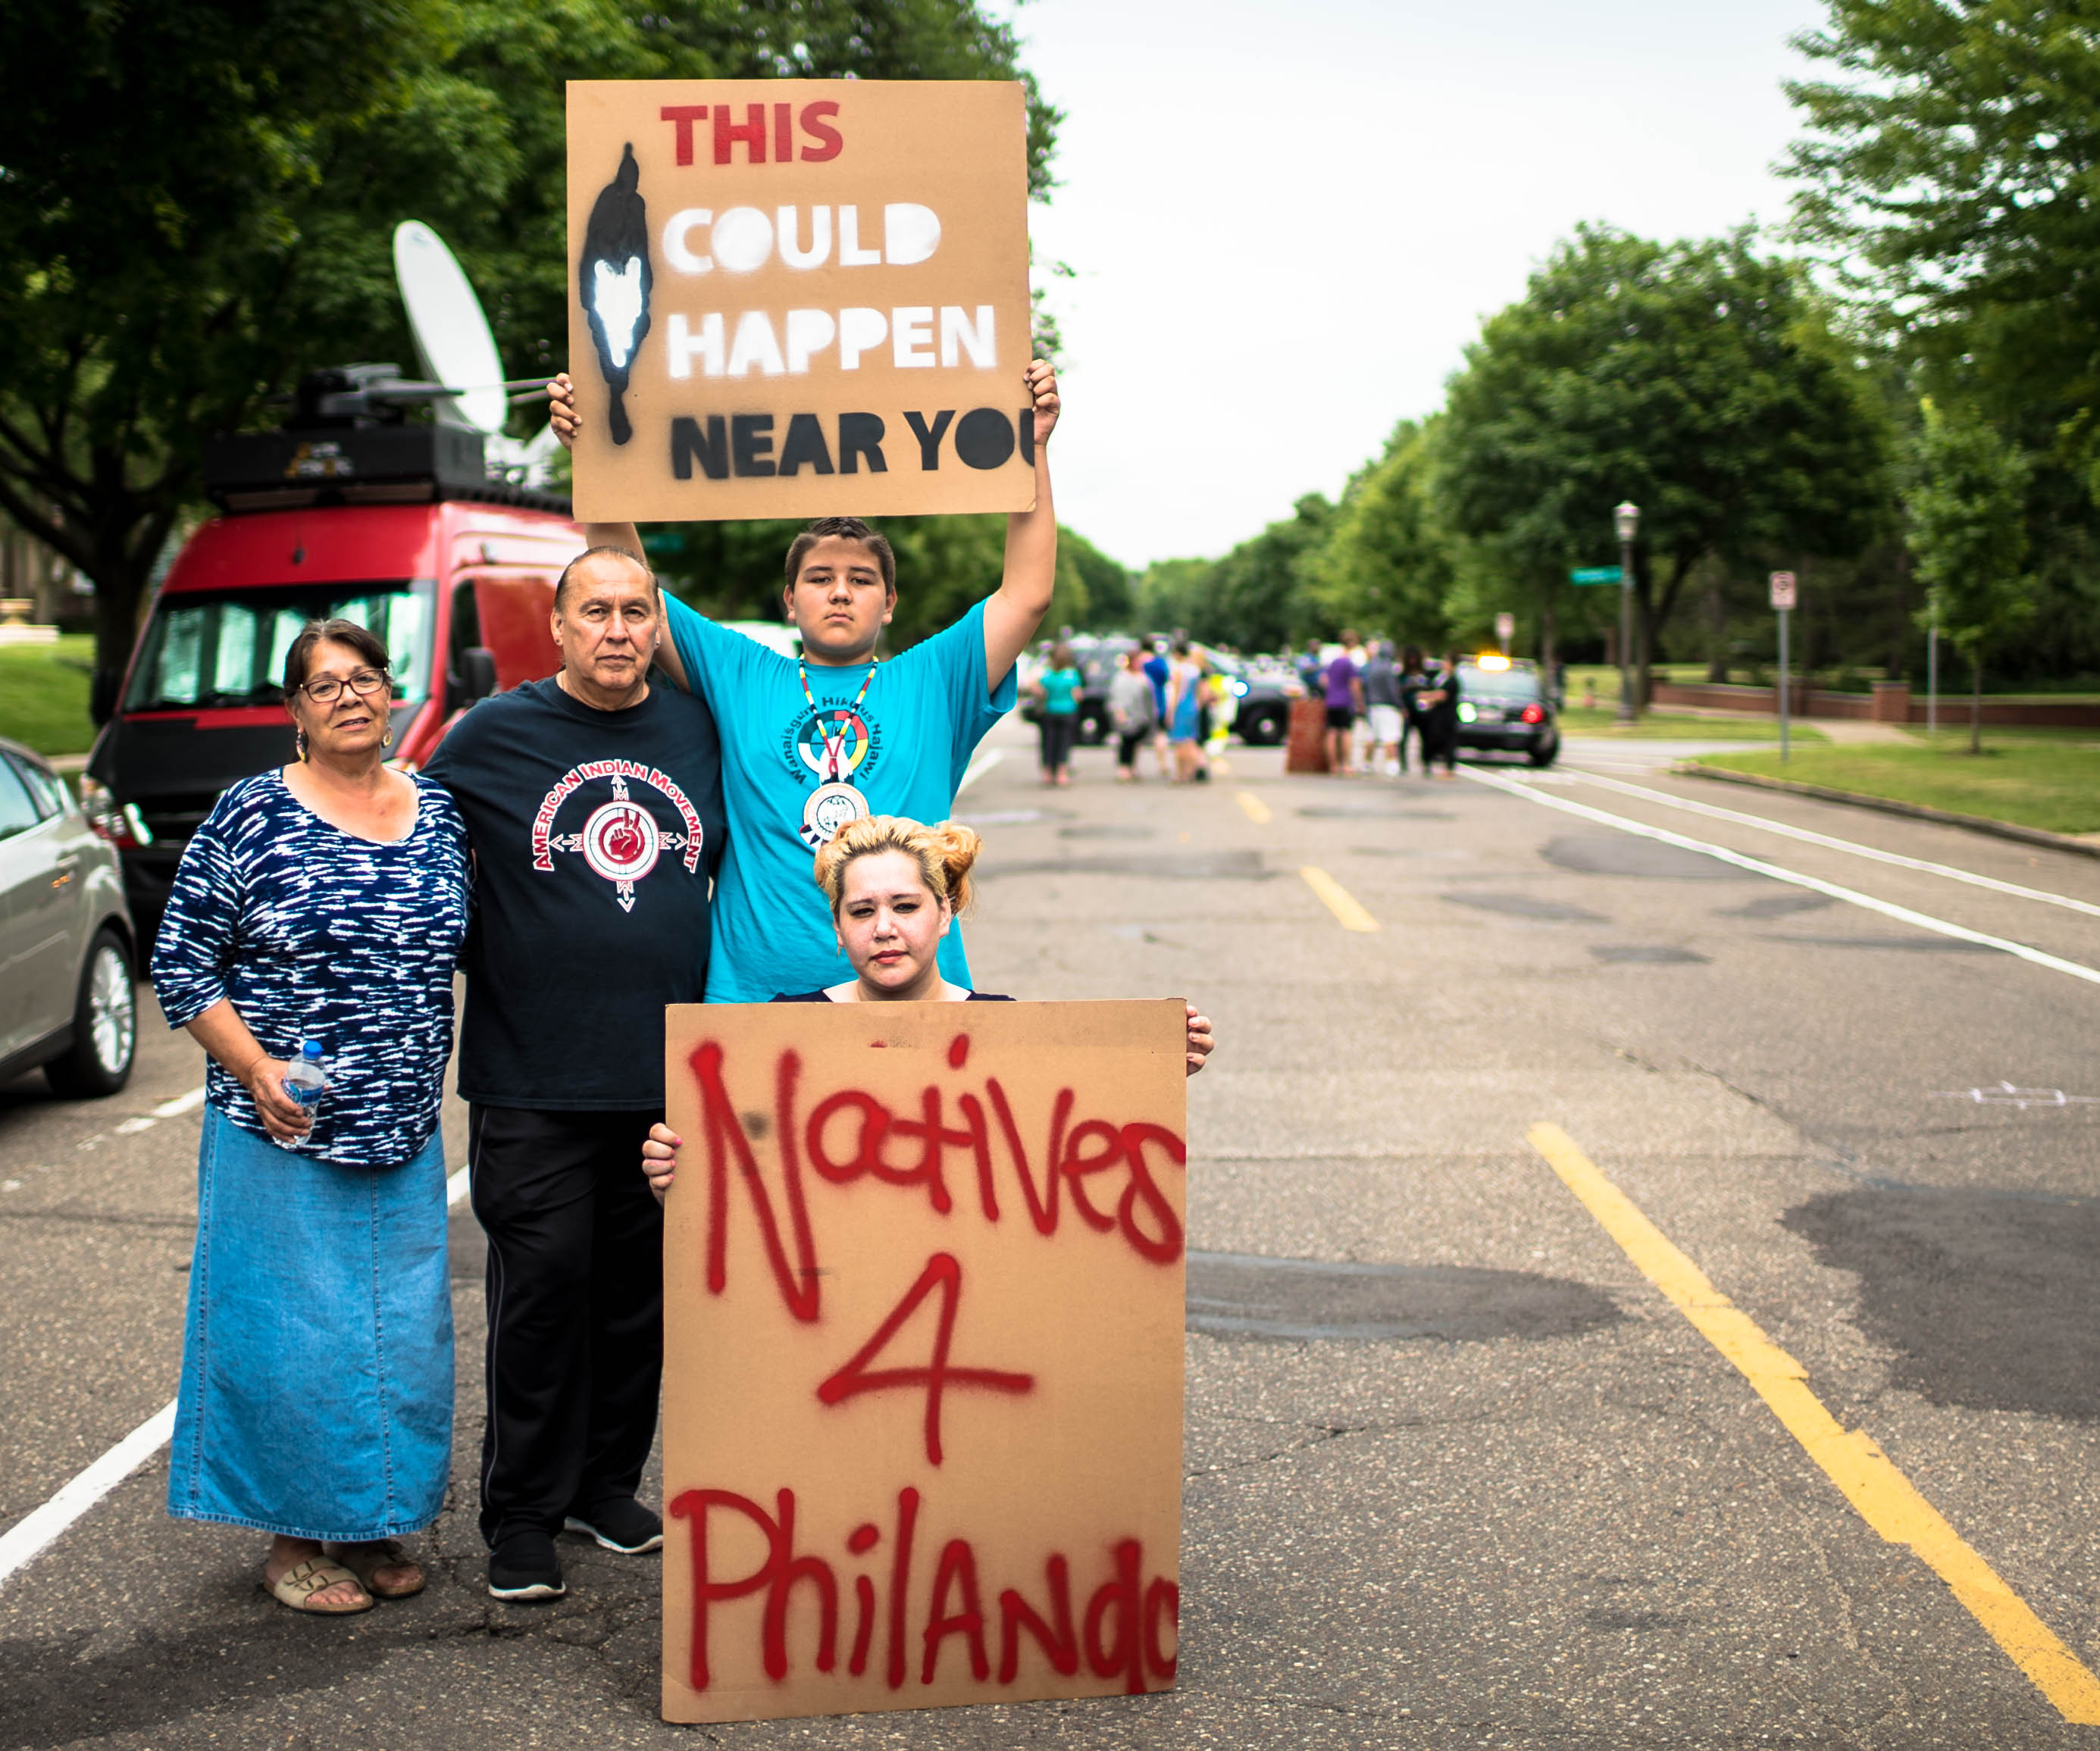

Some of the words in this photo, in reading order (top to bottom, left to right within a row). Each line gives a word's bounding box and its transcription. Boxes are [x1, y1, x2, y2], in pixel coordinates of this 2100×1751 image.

[660, 101, 843, 166] THIS
[662, 202, 941, 273] COULD
[667, 305, 996, 378] HAPPEN
[671, 412, 887, 480] NEAR
[532, 769, 584, 871] AMERICAN
[577, 759, 649, 781] INDIAN
[647, 768, 703, 874] MOVEMENT
[817, 1252, 1034, 1467] 4
